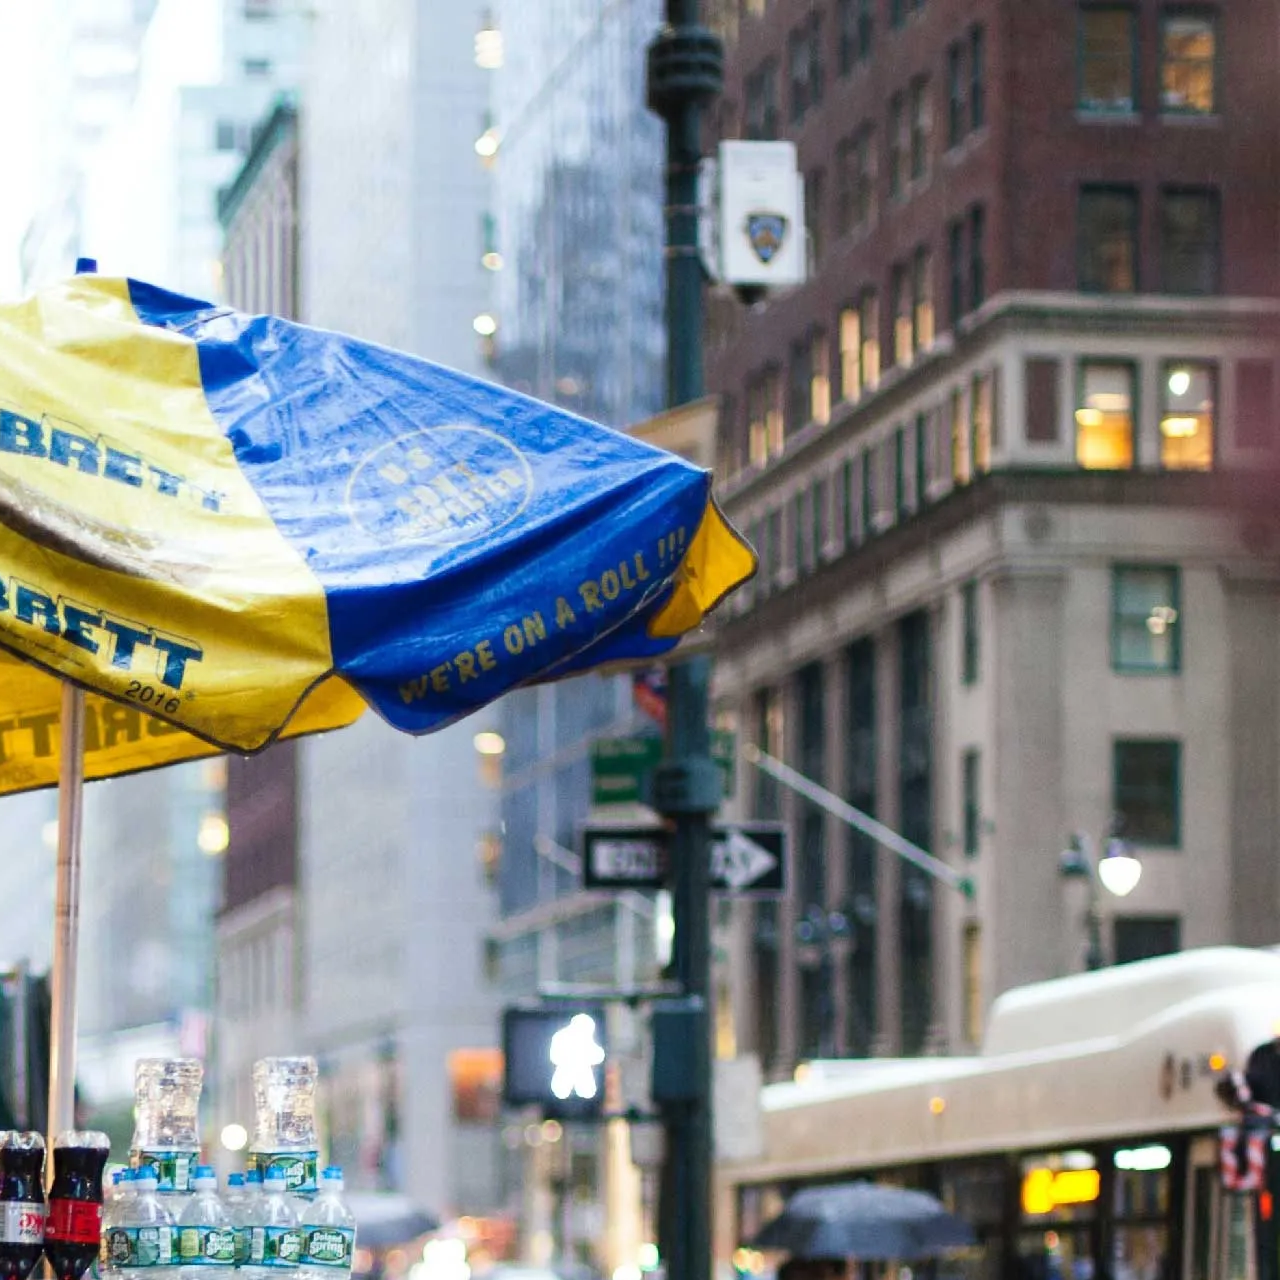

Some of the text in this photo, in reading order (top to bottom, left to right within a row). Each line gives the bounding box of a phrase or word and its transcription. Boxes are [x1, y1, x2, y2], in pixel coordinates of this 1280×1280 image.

[398, 526, 687, 704] WE'RE ON A ROLL !!!
[123, 678, 181, 715] 2016
